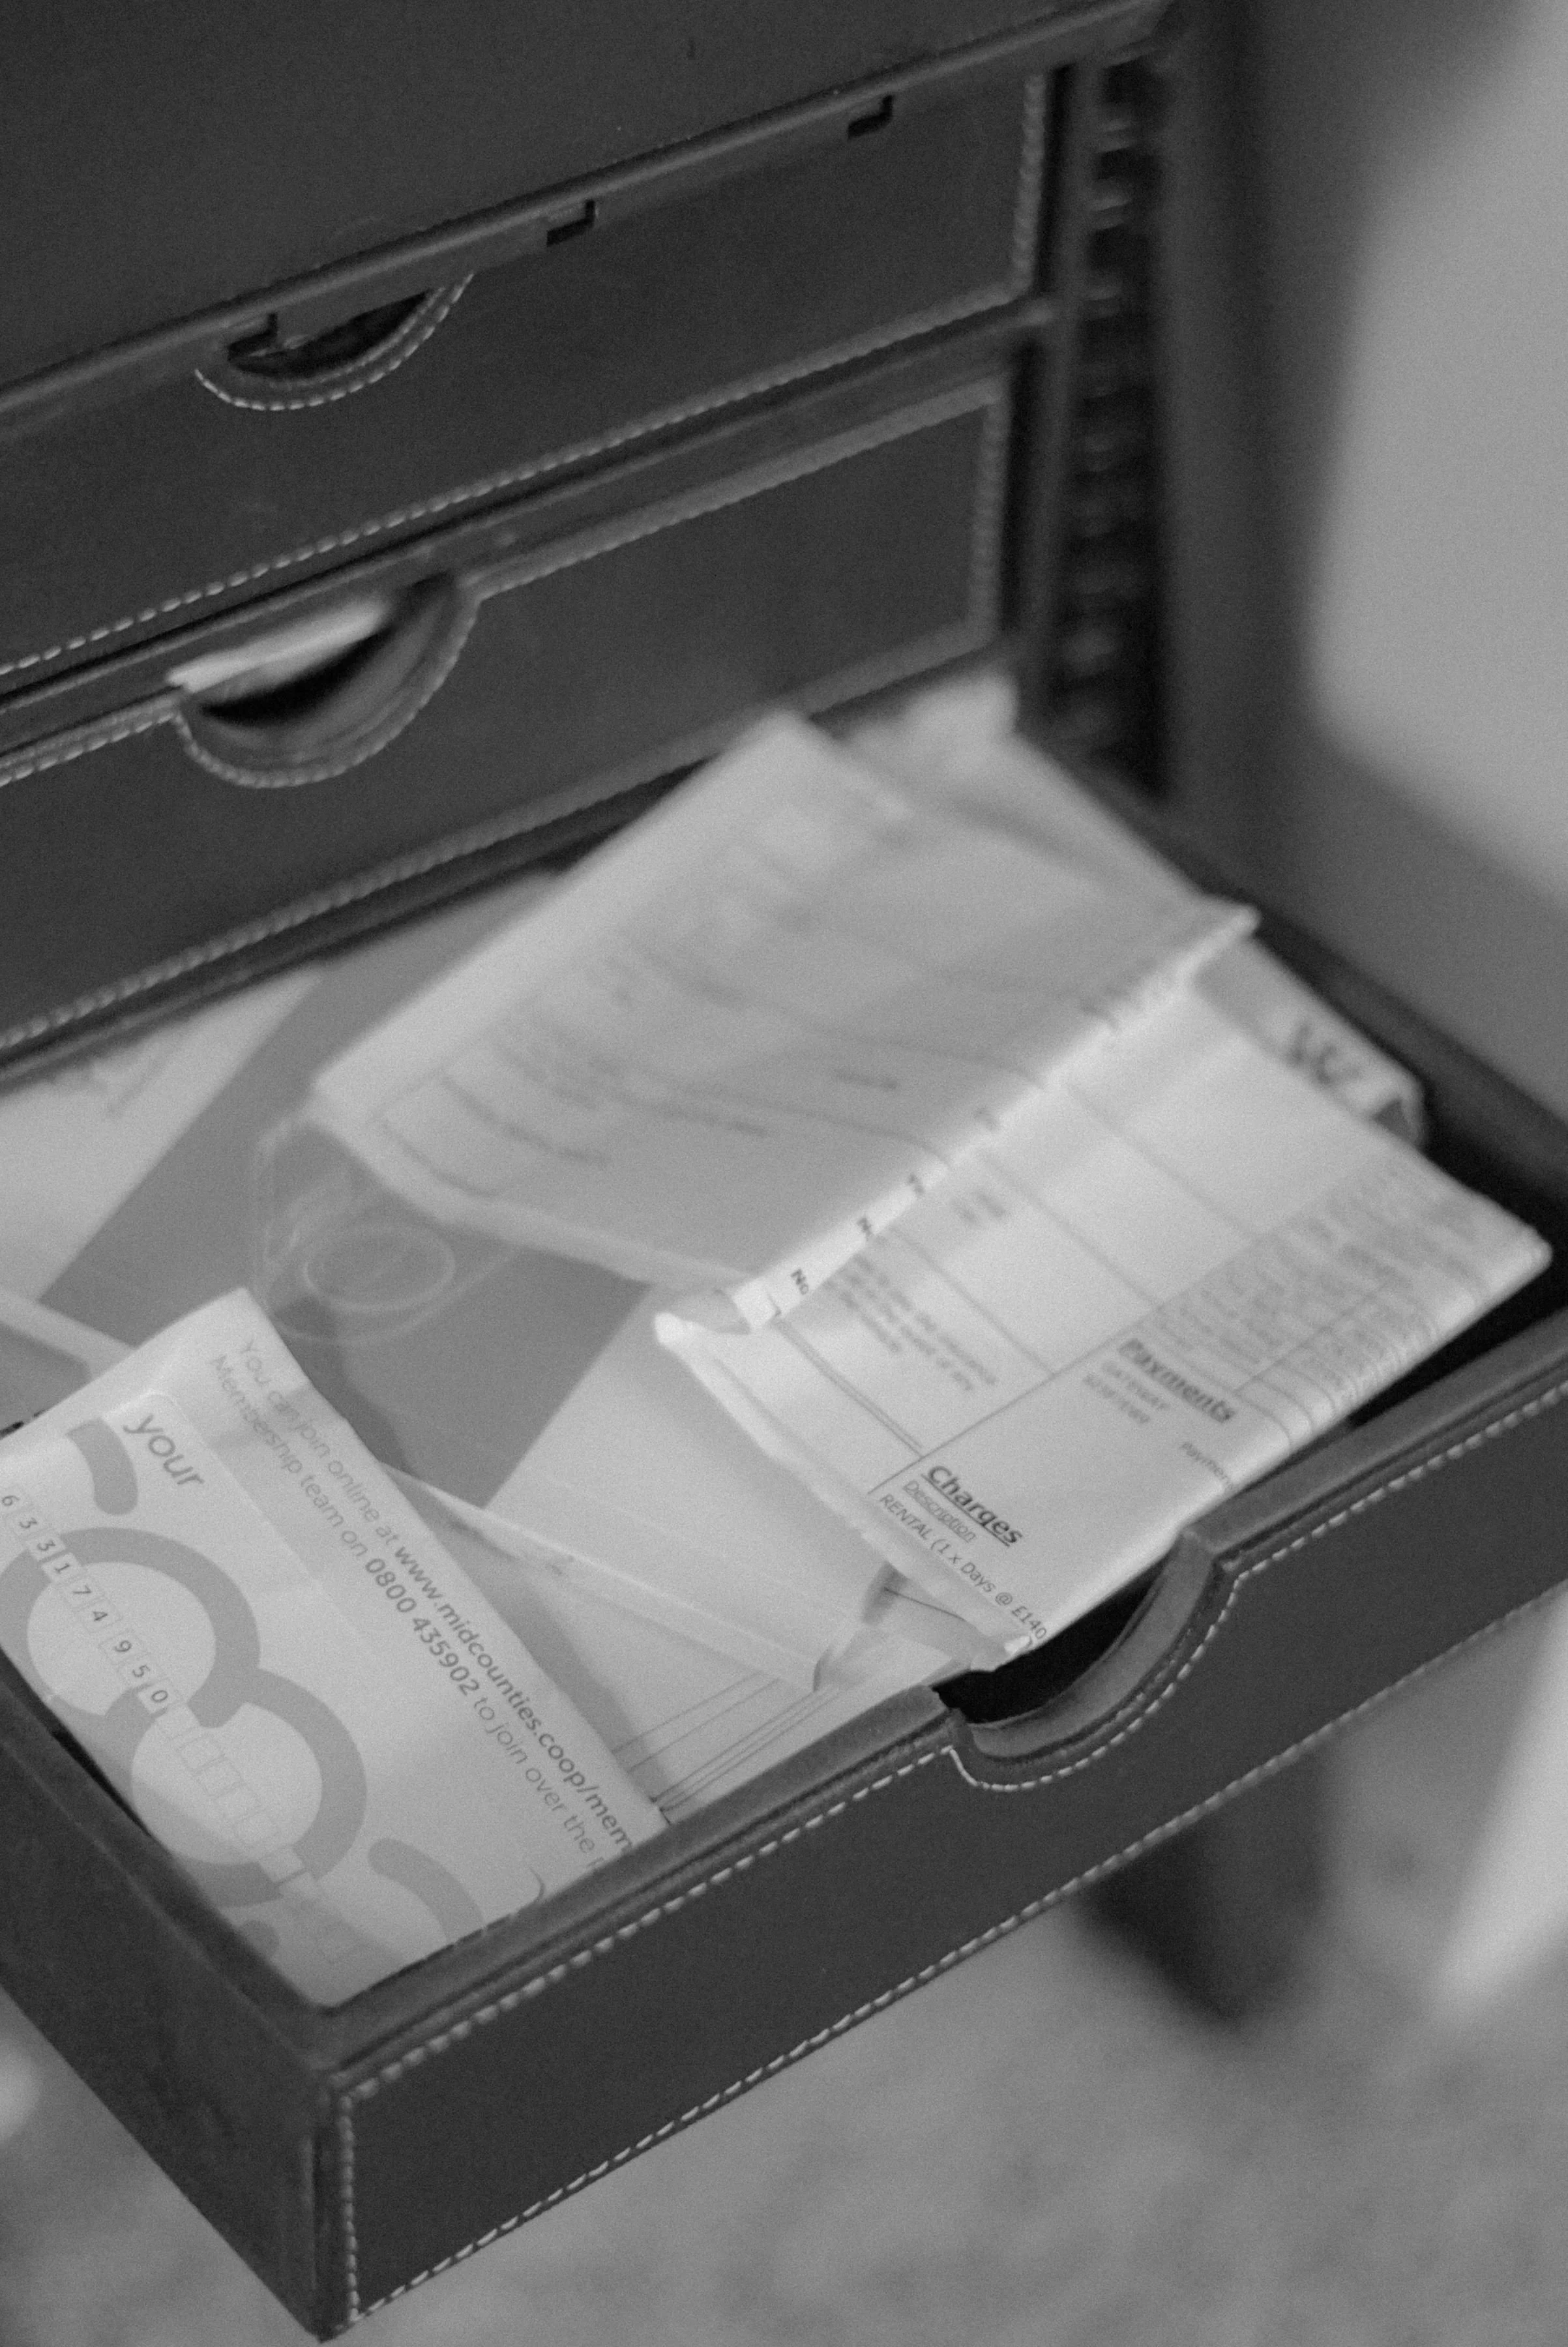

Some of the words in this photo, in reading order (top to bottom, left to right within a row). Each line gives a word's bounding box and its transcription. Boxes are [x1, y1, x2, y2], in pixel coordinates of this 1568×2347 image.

[123, 1414, 205, 1488] your
[328, 1458, 381, 1522] online
[376, 1524, 400, 1546] at
[921, 1465, 1024, 1547] Charges
[880, 1494, 934, 1541] RENTAL
[960, 1562, 996, 1593] Days
[994, 1591, 1013, 1606] @
[299, 1474, 344, 1528] team
[341, 1529, 369, 1557] on
[365, 1557, 417, 1614] 0800
[411, 1616, 481, 1696] 435902
[473, 1698, 496, 1722] to
[486, 1722, 528, 1764] join
[525, 1764, 566, 1813] over
[563, 1814, 595, 1853] the
